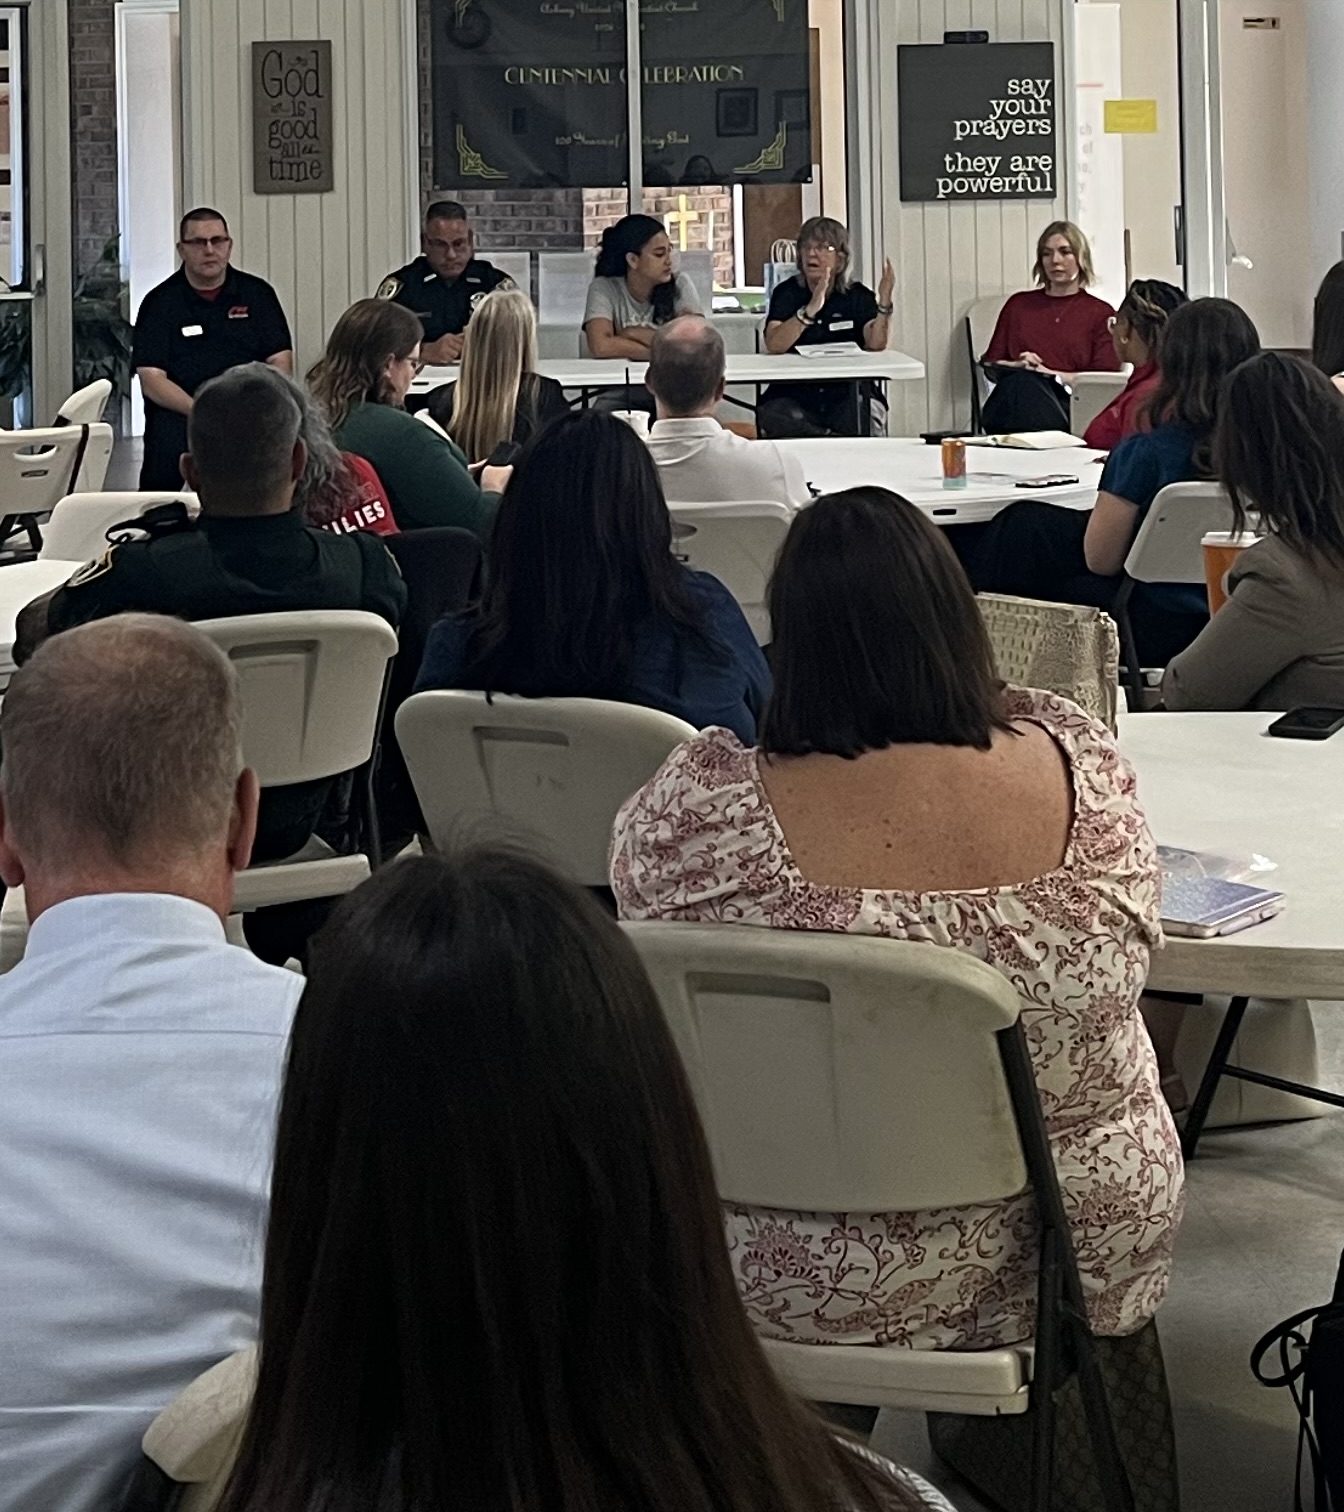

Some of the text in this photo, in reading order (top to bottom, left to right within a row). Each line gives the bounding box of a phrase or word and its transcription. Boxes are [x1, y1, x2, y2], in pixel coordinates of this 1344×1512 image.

[261, 49, 324, 99] God
[505, 64, 745, 86] CENTENNIAL CLEBRATION
[1007, 78, 1052, 99] say
[989, 98, 1052, 120] your
[268, 107, 319, 149] good
[953, 117, 1052, 141] prayers
[269, 156, 324, 183] time
[944, 152, 1002, 176] they
[1010, 154, 1052, 173] are
[936, 172, 1053, 199] powerful
[322, 500, 385, 535] ILIES
